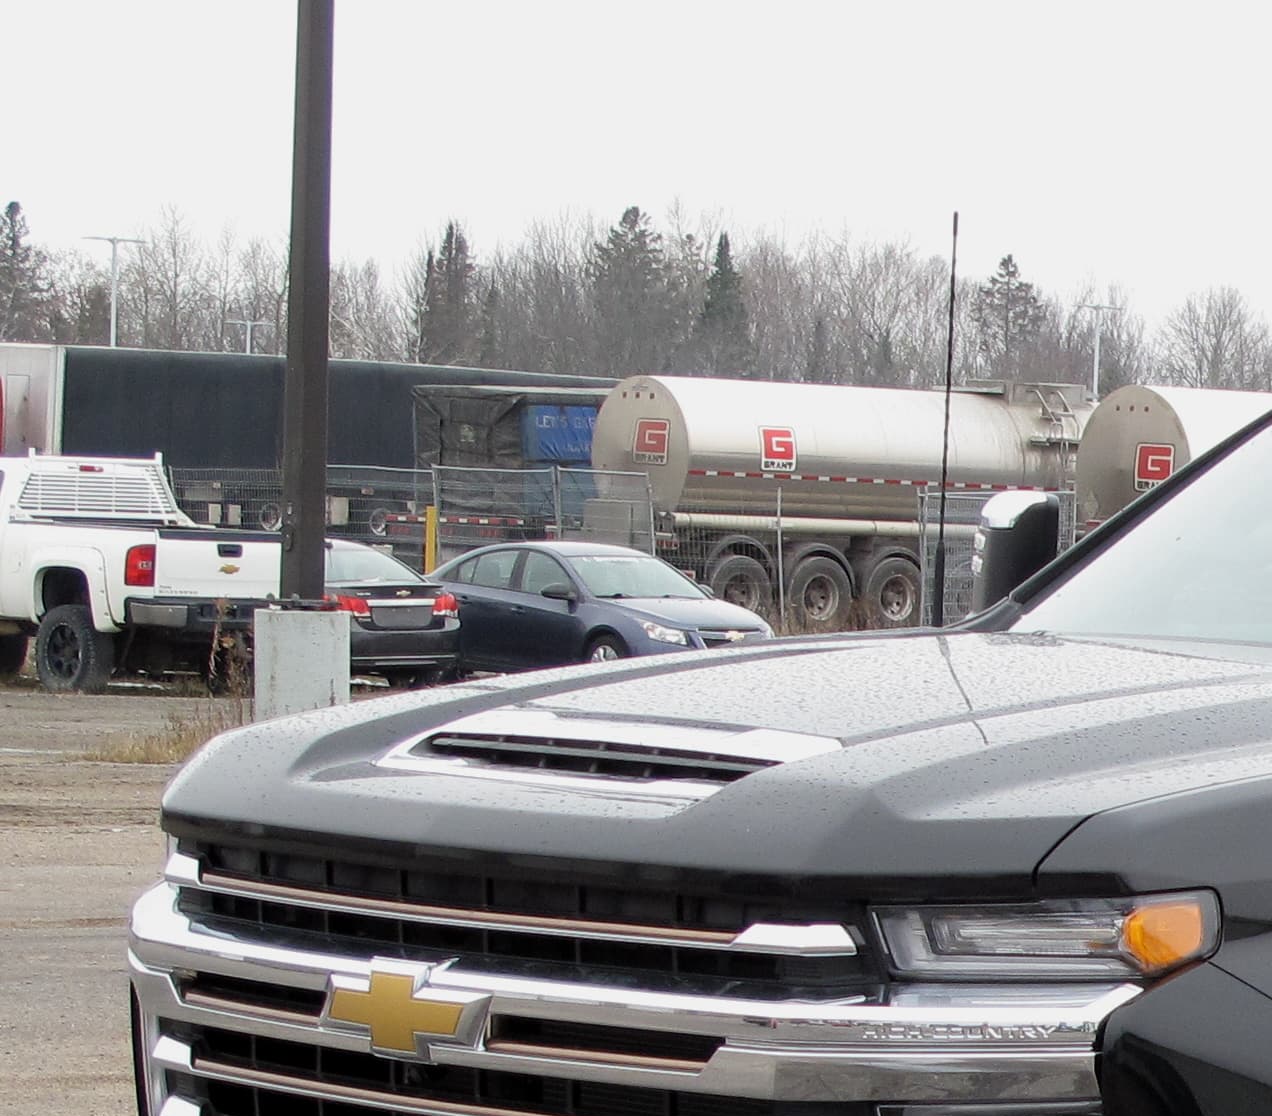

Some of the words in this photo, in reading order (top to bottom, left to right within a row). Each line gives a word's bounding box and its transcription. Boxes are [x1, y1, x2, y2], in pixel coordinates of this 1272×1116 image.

[763, 461, 793, 470] GRANT
[1137, 480, 1160, 489] GRA
[932, 1024, 1057, 1040] COUNTRY
